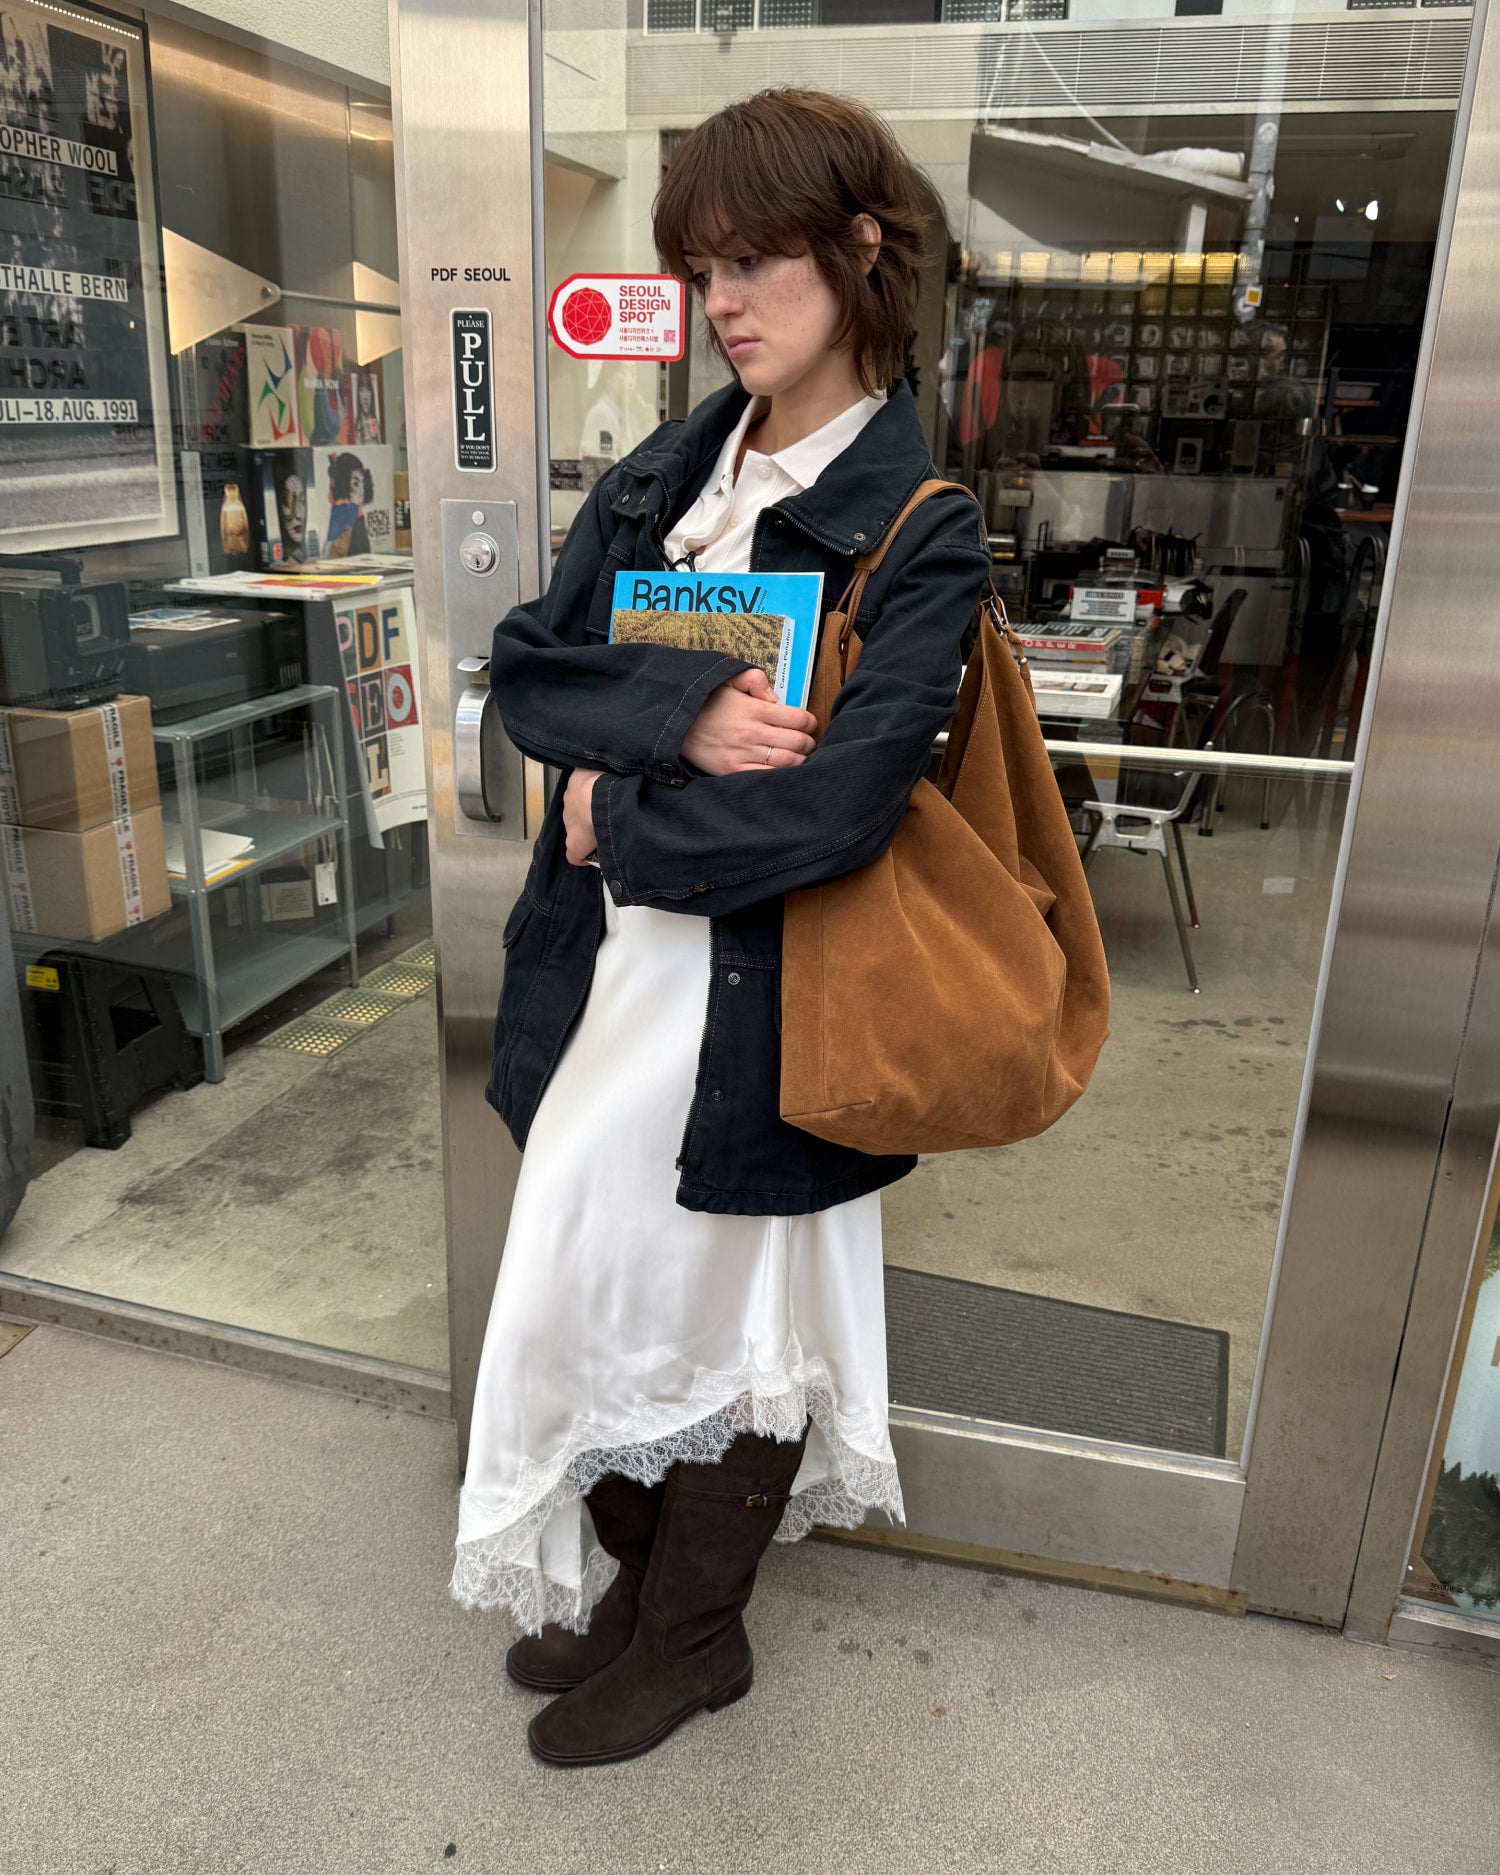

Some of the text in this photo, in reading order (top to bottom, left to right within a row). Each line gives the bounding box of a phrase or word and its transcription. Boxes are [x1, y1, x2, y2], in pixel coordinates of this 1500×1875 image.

[67, 142, 116, 173] WOOL
[432, 268, 510, 281] PDF SEOUL
[81, 275, 126, 300] BERN
[620, 285, 665, 297] SEOUL
[619, 298, 670, 310] DESIGN
[619, 311, 656, 323] SPOT
[460, 332, 486, 441] PULL
[103, 401, 136, 421] 1991
[117, 769, 129, 814] FRAGILE
[11, 827, 25, 874] FRAGILE
[127, 852, 139, 896] FRAGILE
